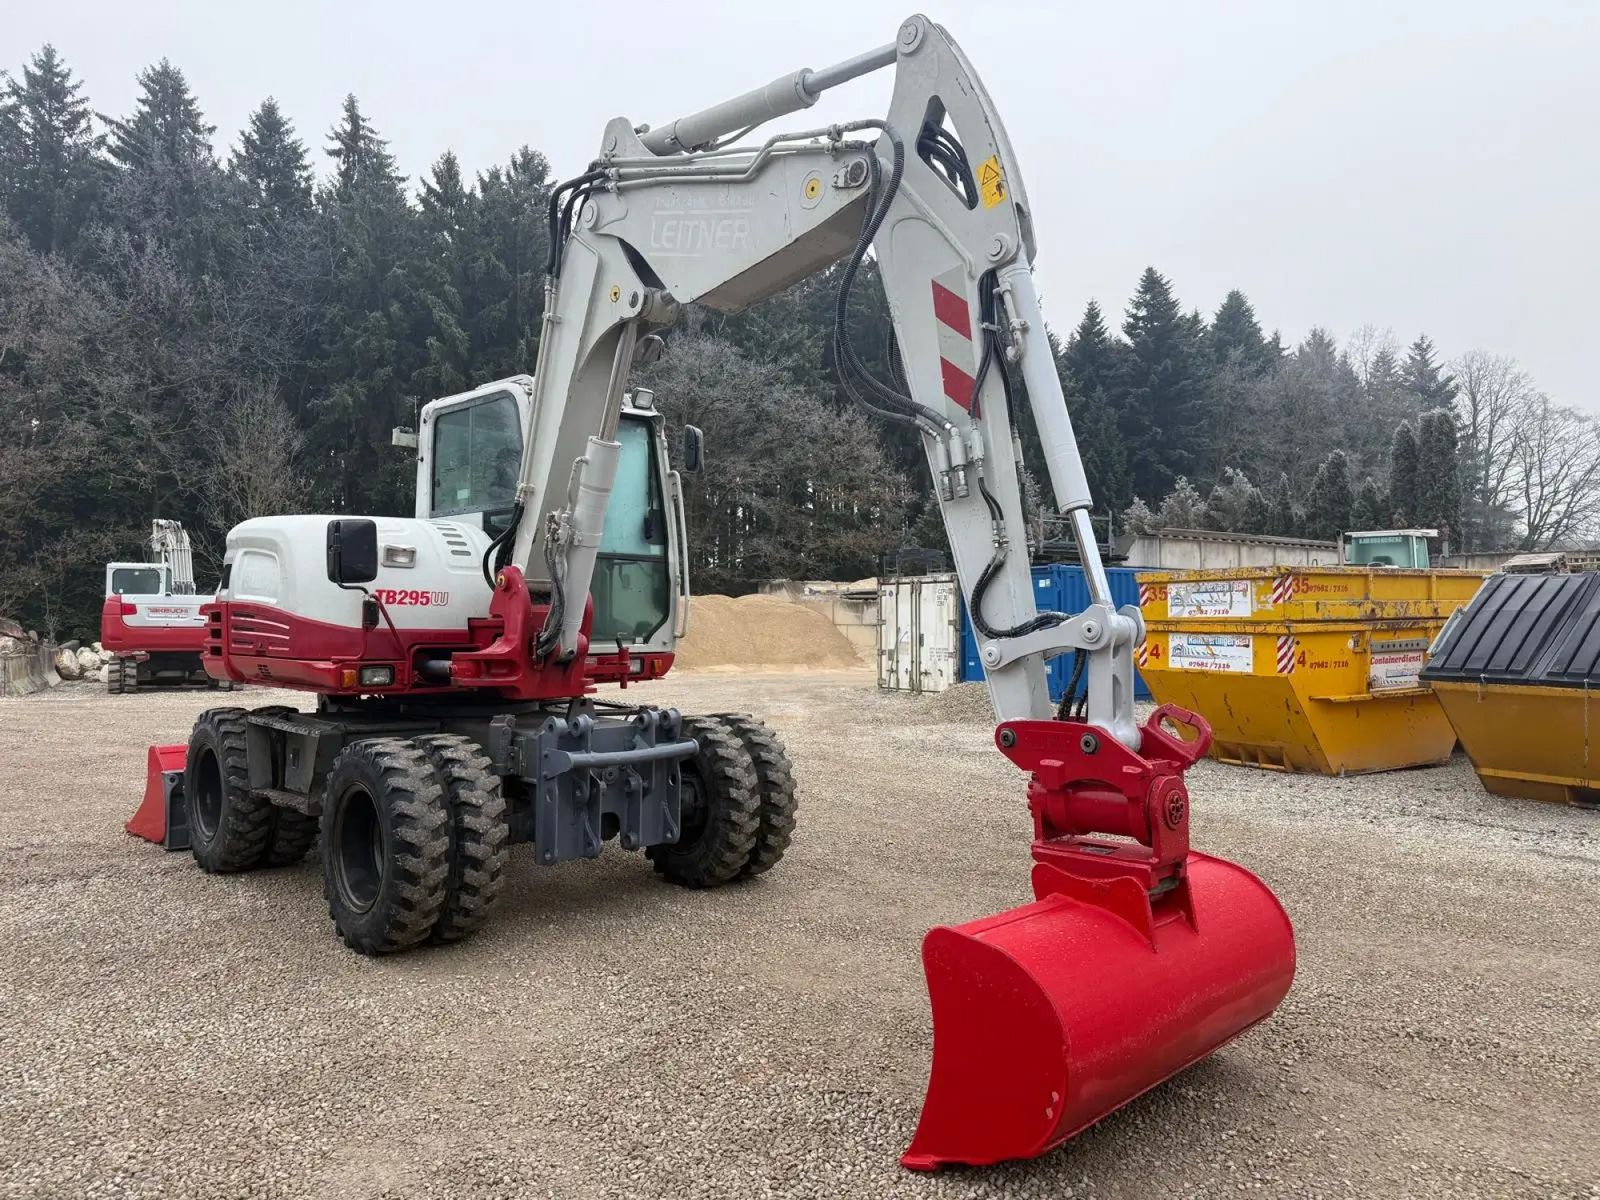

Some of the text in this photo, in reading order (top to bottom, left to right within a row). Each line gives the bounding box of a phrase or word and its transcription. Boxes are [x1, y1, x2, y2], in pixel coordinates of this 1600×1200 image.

[650, 216, 752, 250] LEITNER
[1147, 586, 1168, 602] 35
[1292, 577, 1310, 594] 35
[375, 589, 449, 607] TB295W
[1149, 643, 1161, 660] 4
[1297, 650, 1307, 668] 4
[1370, 654, 1421, 665] Containerdienst
